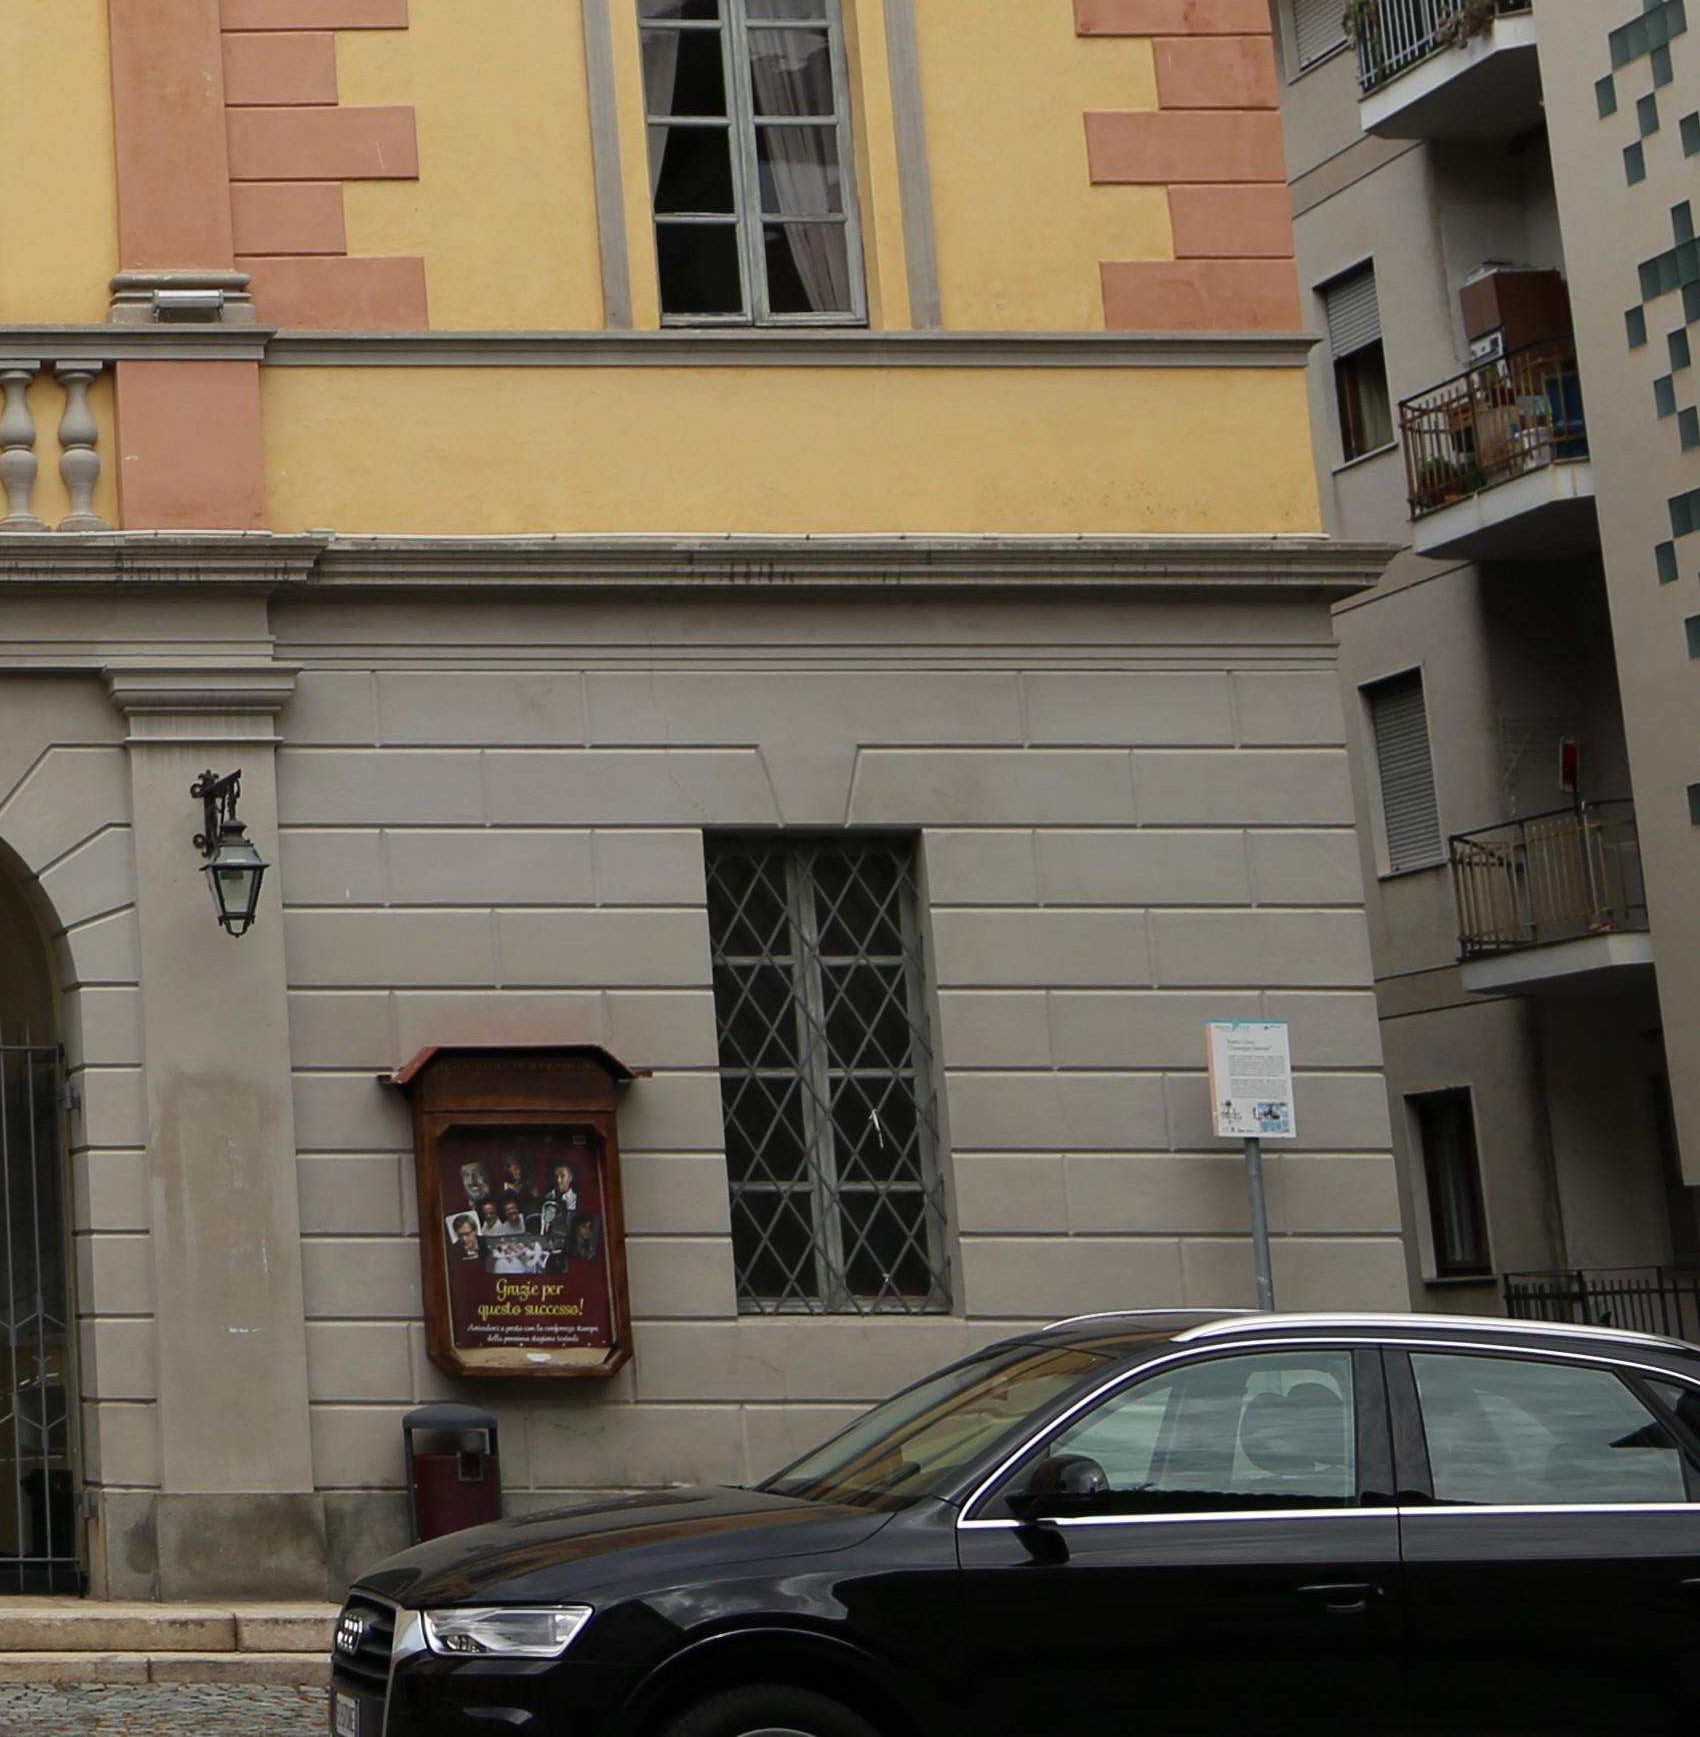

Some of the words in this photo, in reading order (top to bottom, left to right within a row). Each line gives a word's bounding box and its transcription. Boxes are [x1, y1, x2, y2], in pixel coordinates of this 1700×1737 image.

[495, 1277, 540, 1302] Grazie
[541, 1284, 564, 1302] per
[477, 1301, 522, 1322] questo
[524, 1297, 584, 1316] successo!
